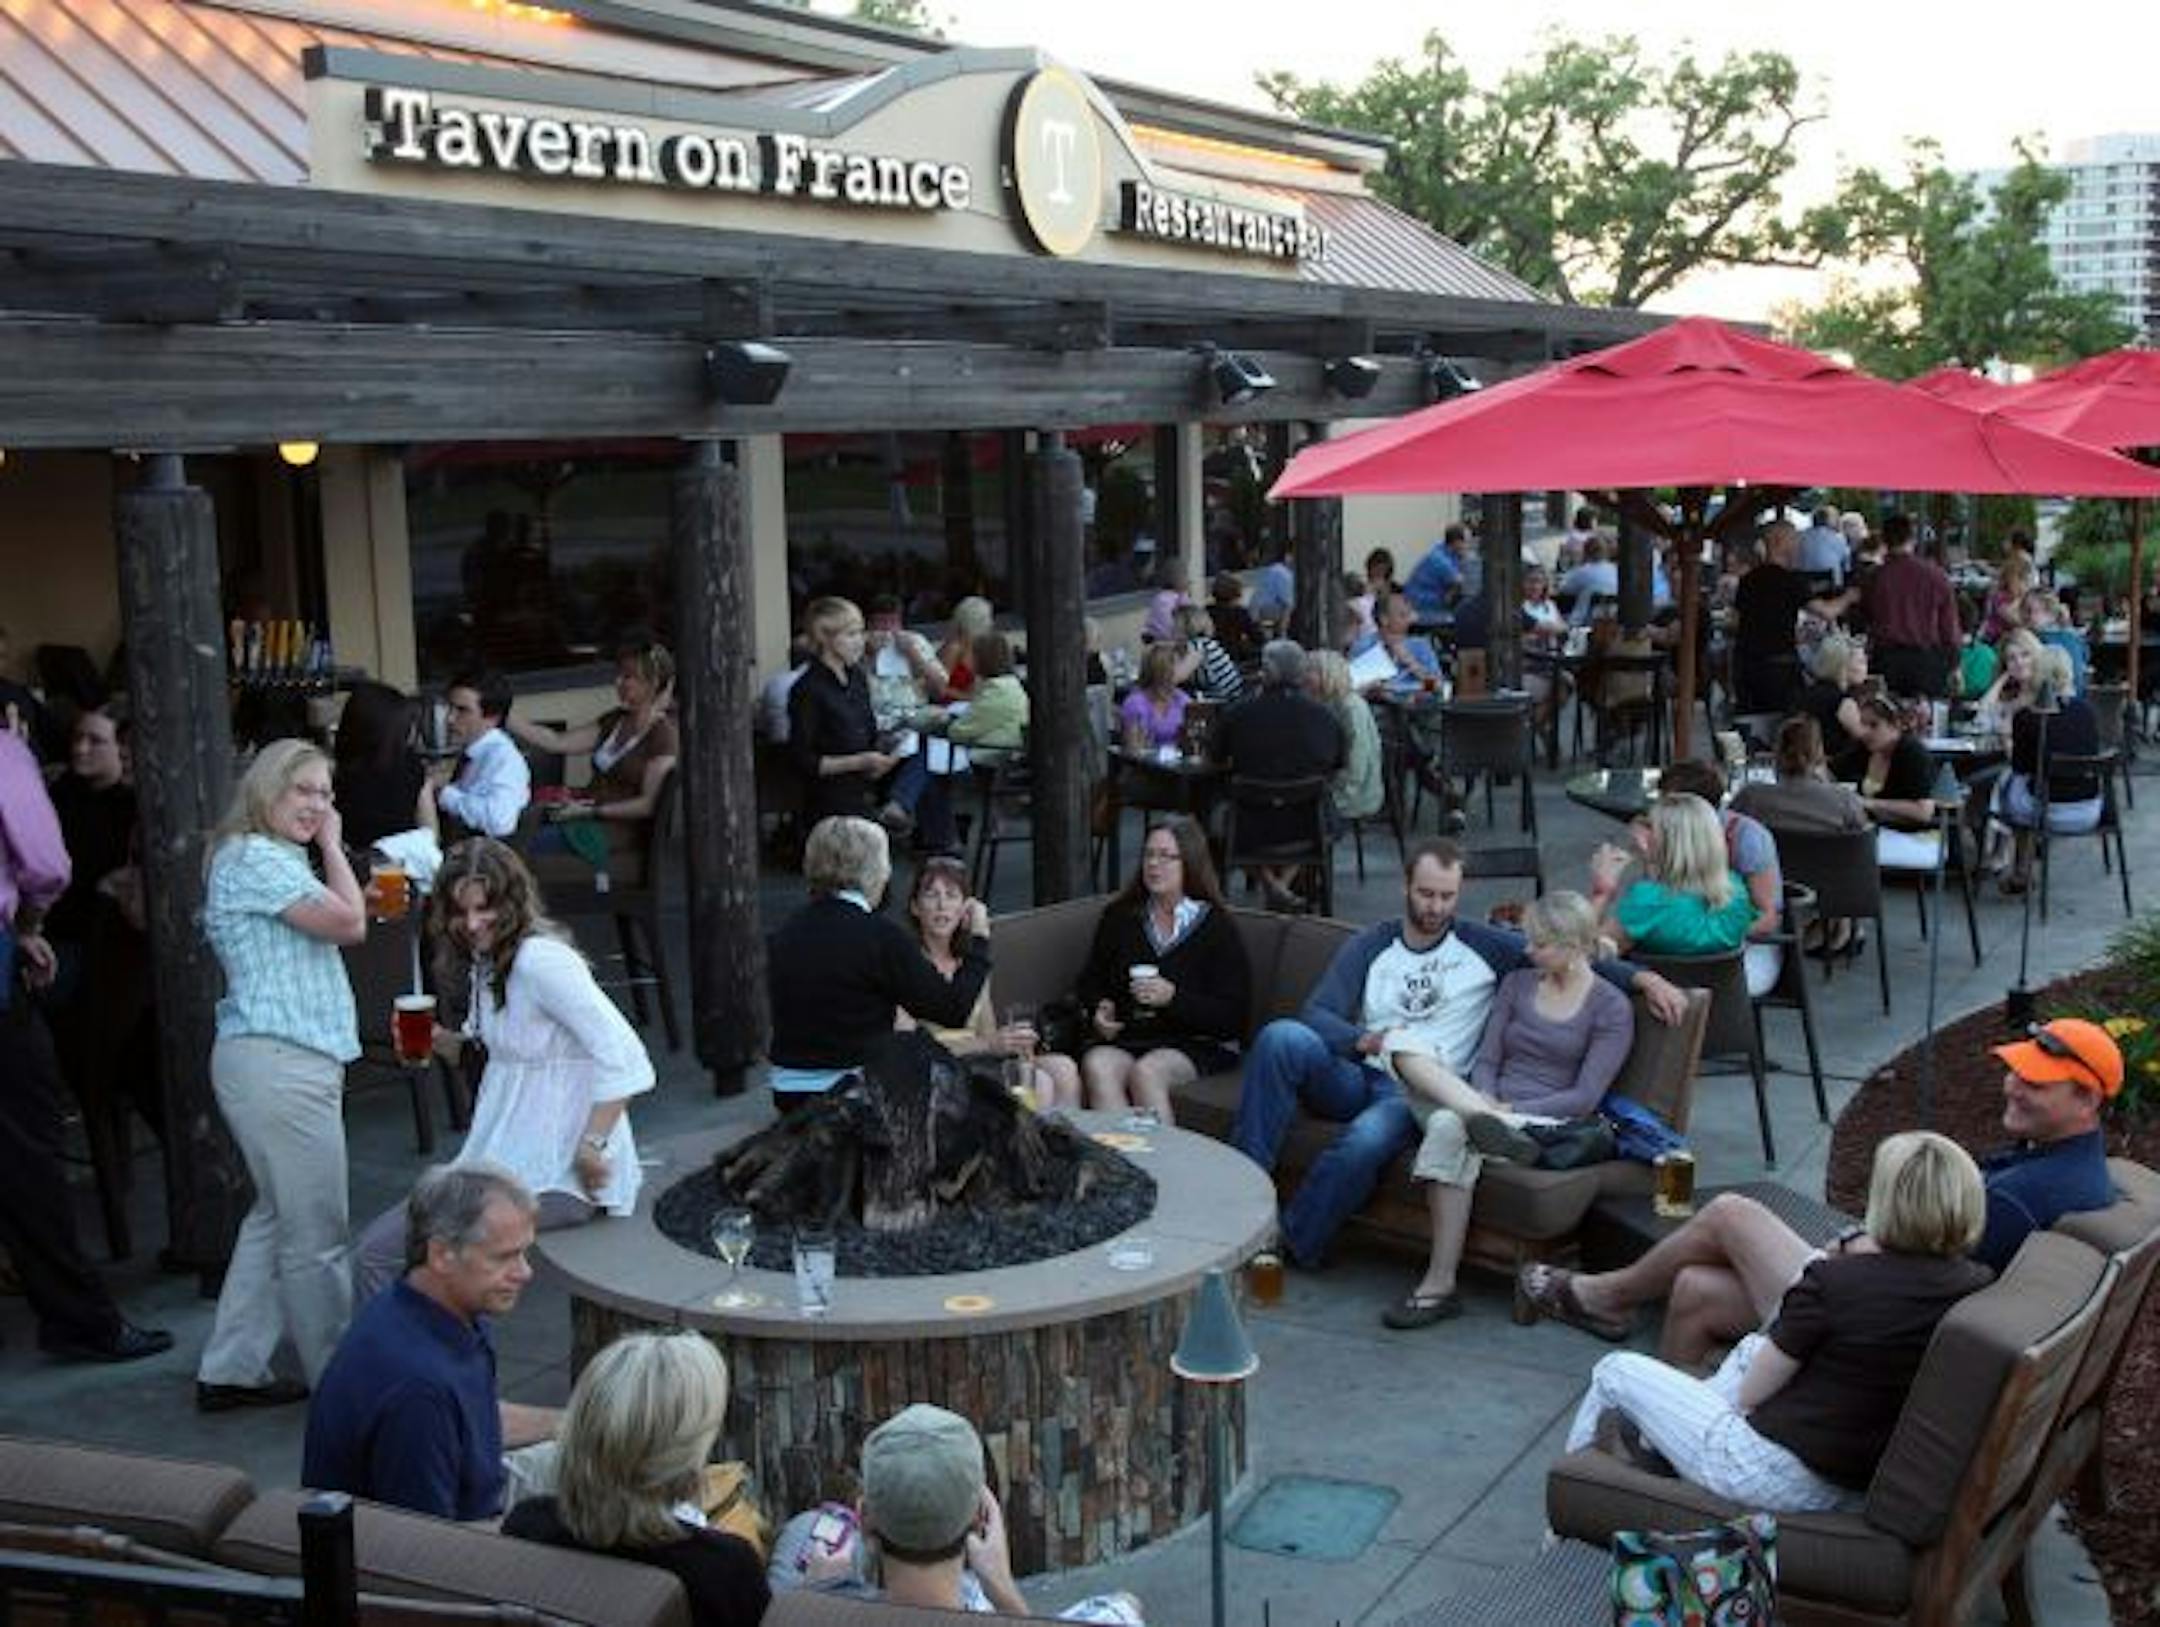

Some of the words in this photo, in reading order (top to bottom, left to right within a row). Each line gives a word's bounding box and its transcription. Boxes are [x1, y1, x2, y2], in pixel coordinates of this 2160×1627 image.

[383, 88, 654, 181] Tavern
[676, 134, 752, 188] on
[774, 133, 971, 209] France
[1042, 120, 1075, 204] T
